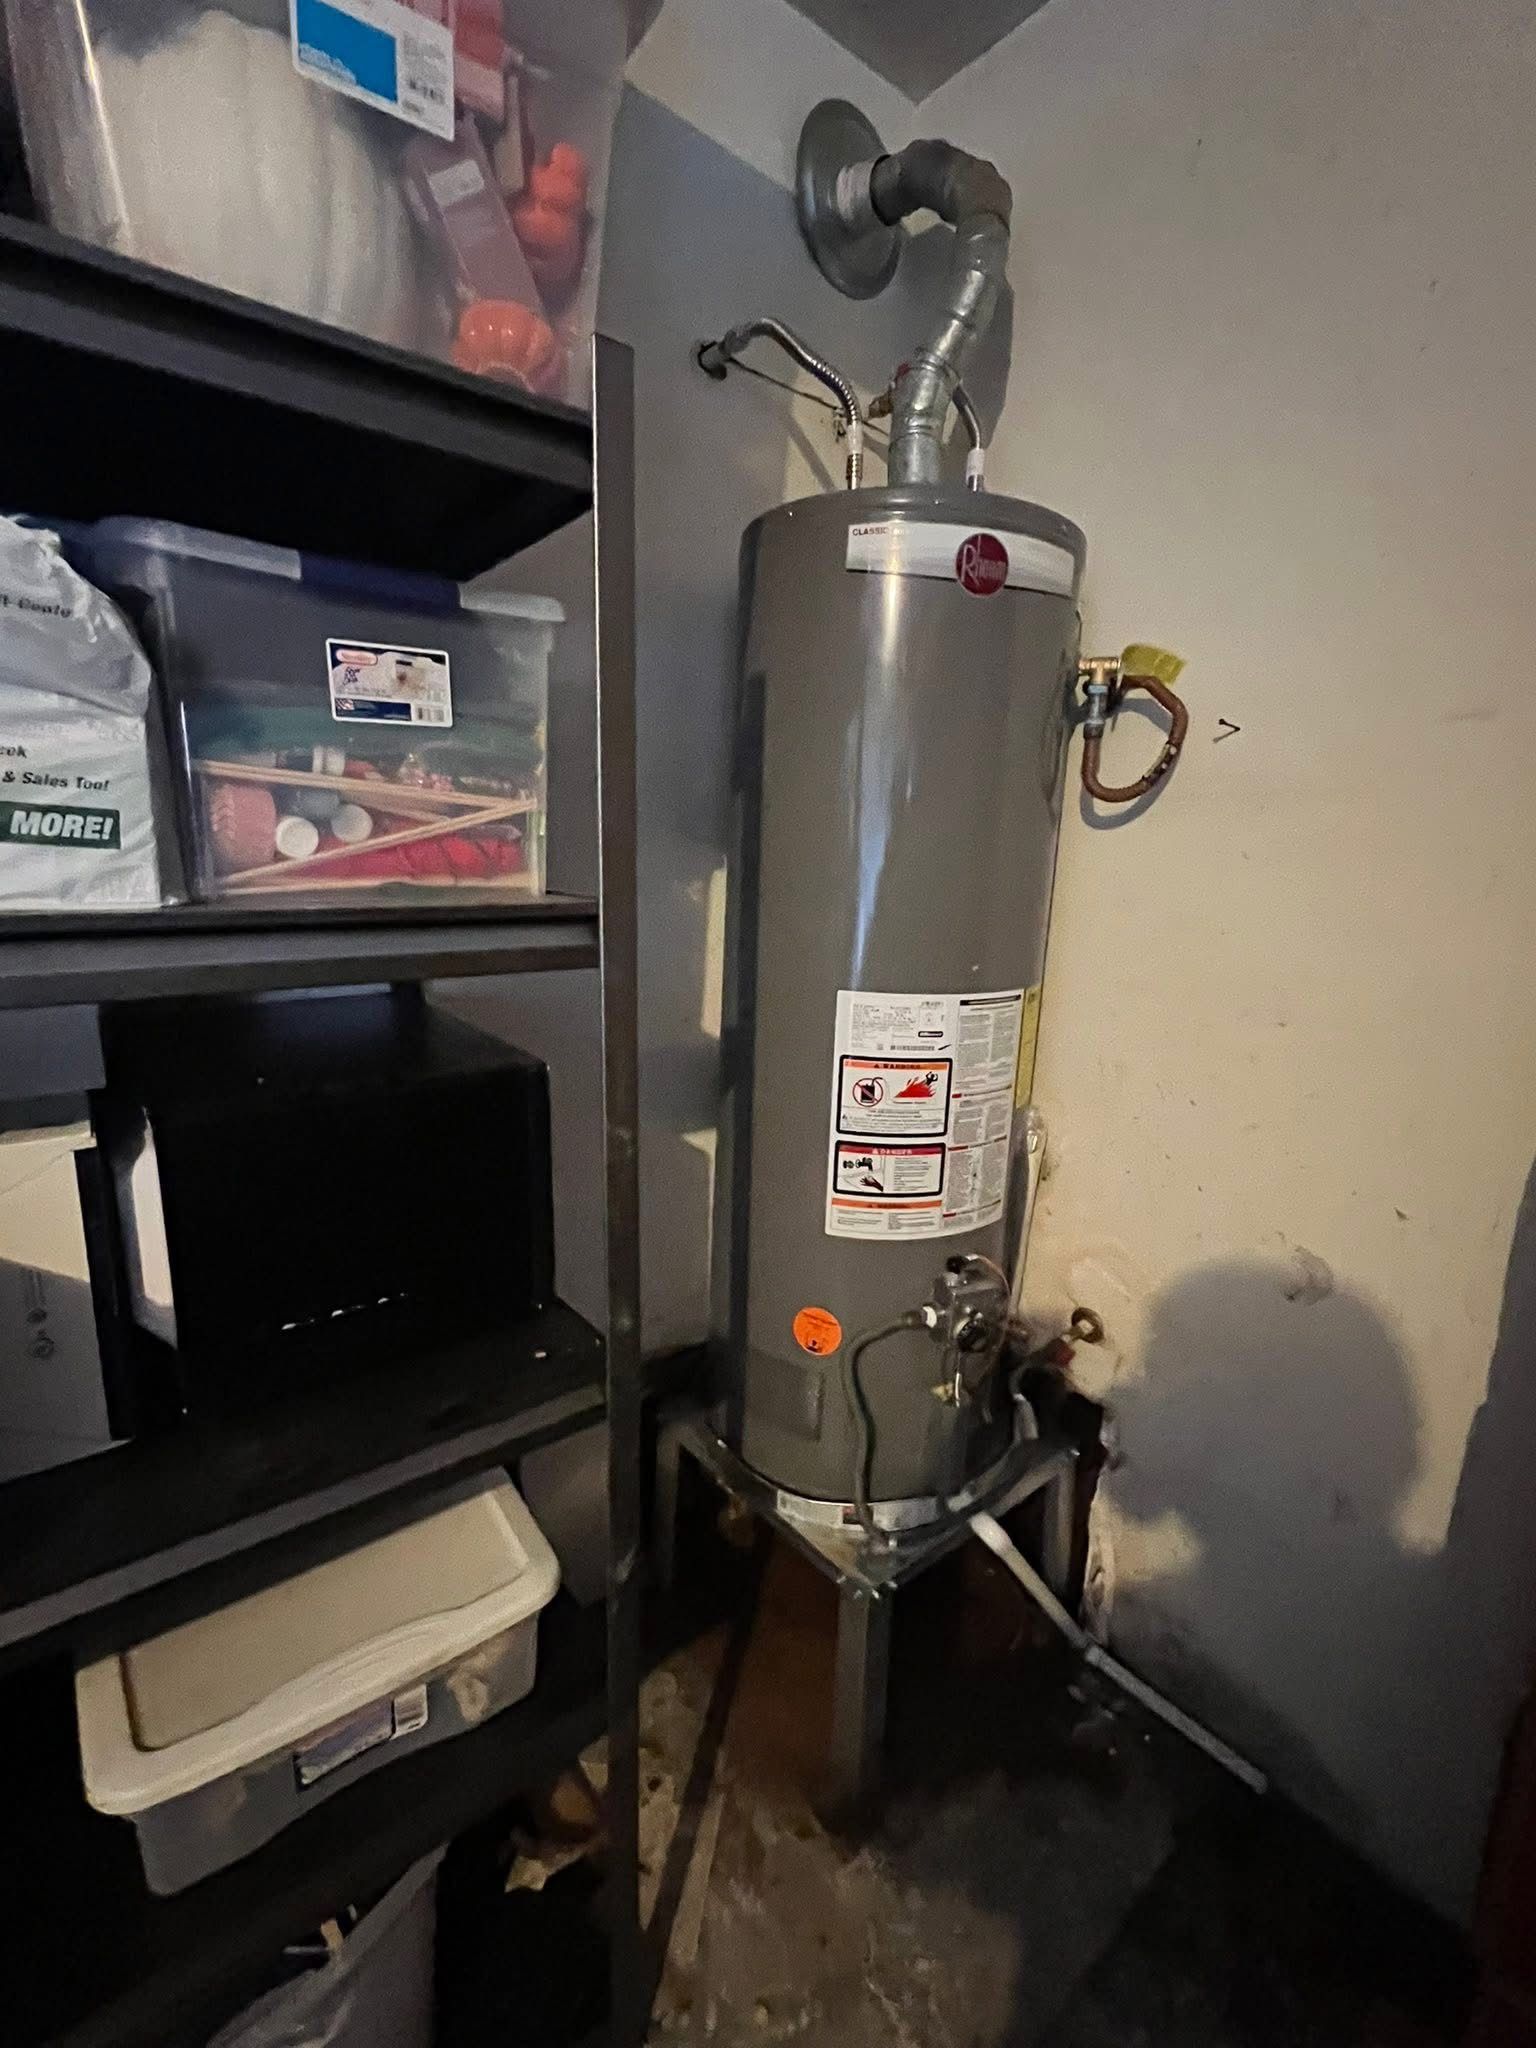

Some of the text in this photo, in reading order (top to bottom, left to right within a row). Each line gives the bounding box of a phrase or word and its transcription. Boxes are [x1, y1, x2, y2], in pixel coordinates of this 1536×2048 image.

[2, 771, 16, 783] &
[22, 772, 68, 788] Sales
[10, 810, 114, 841] MORE!
